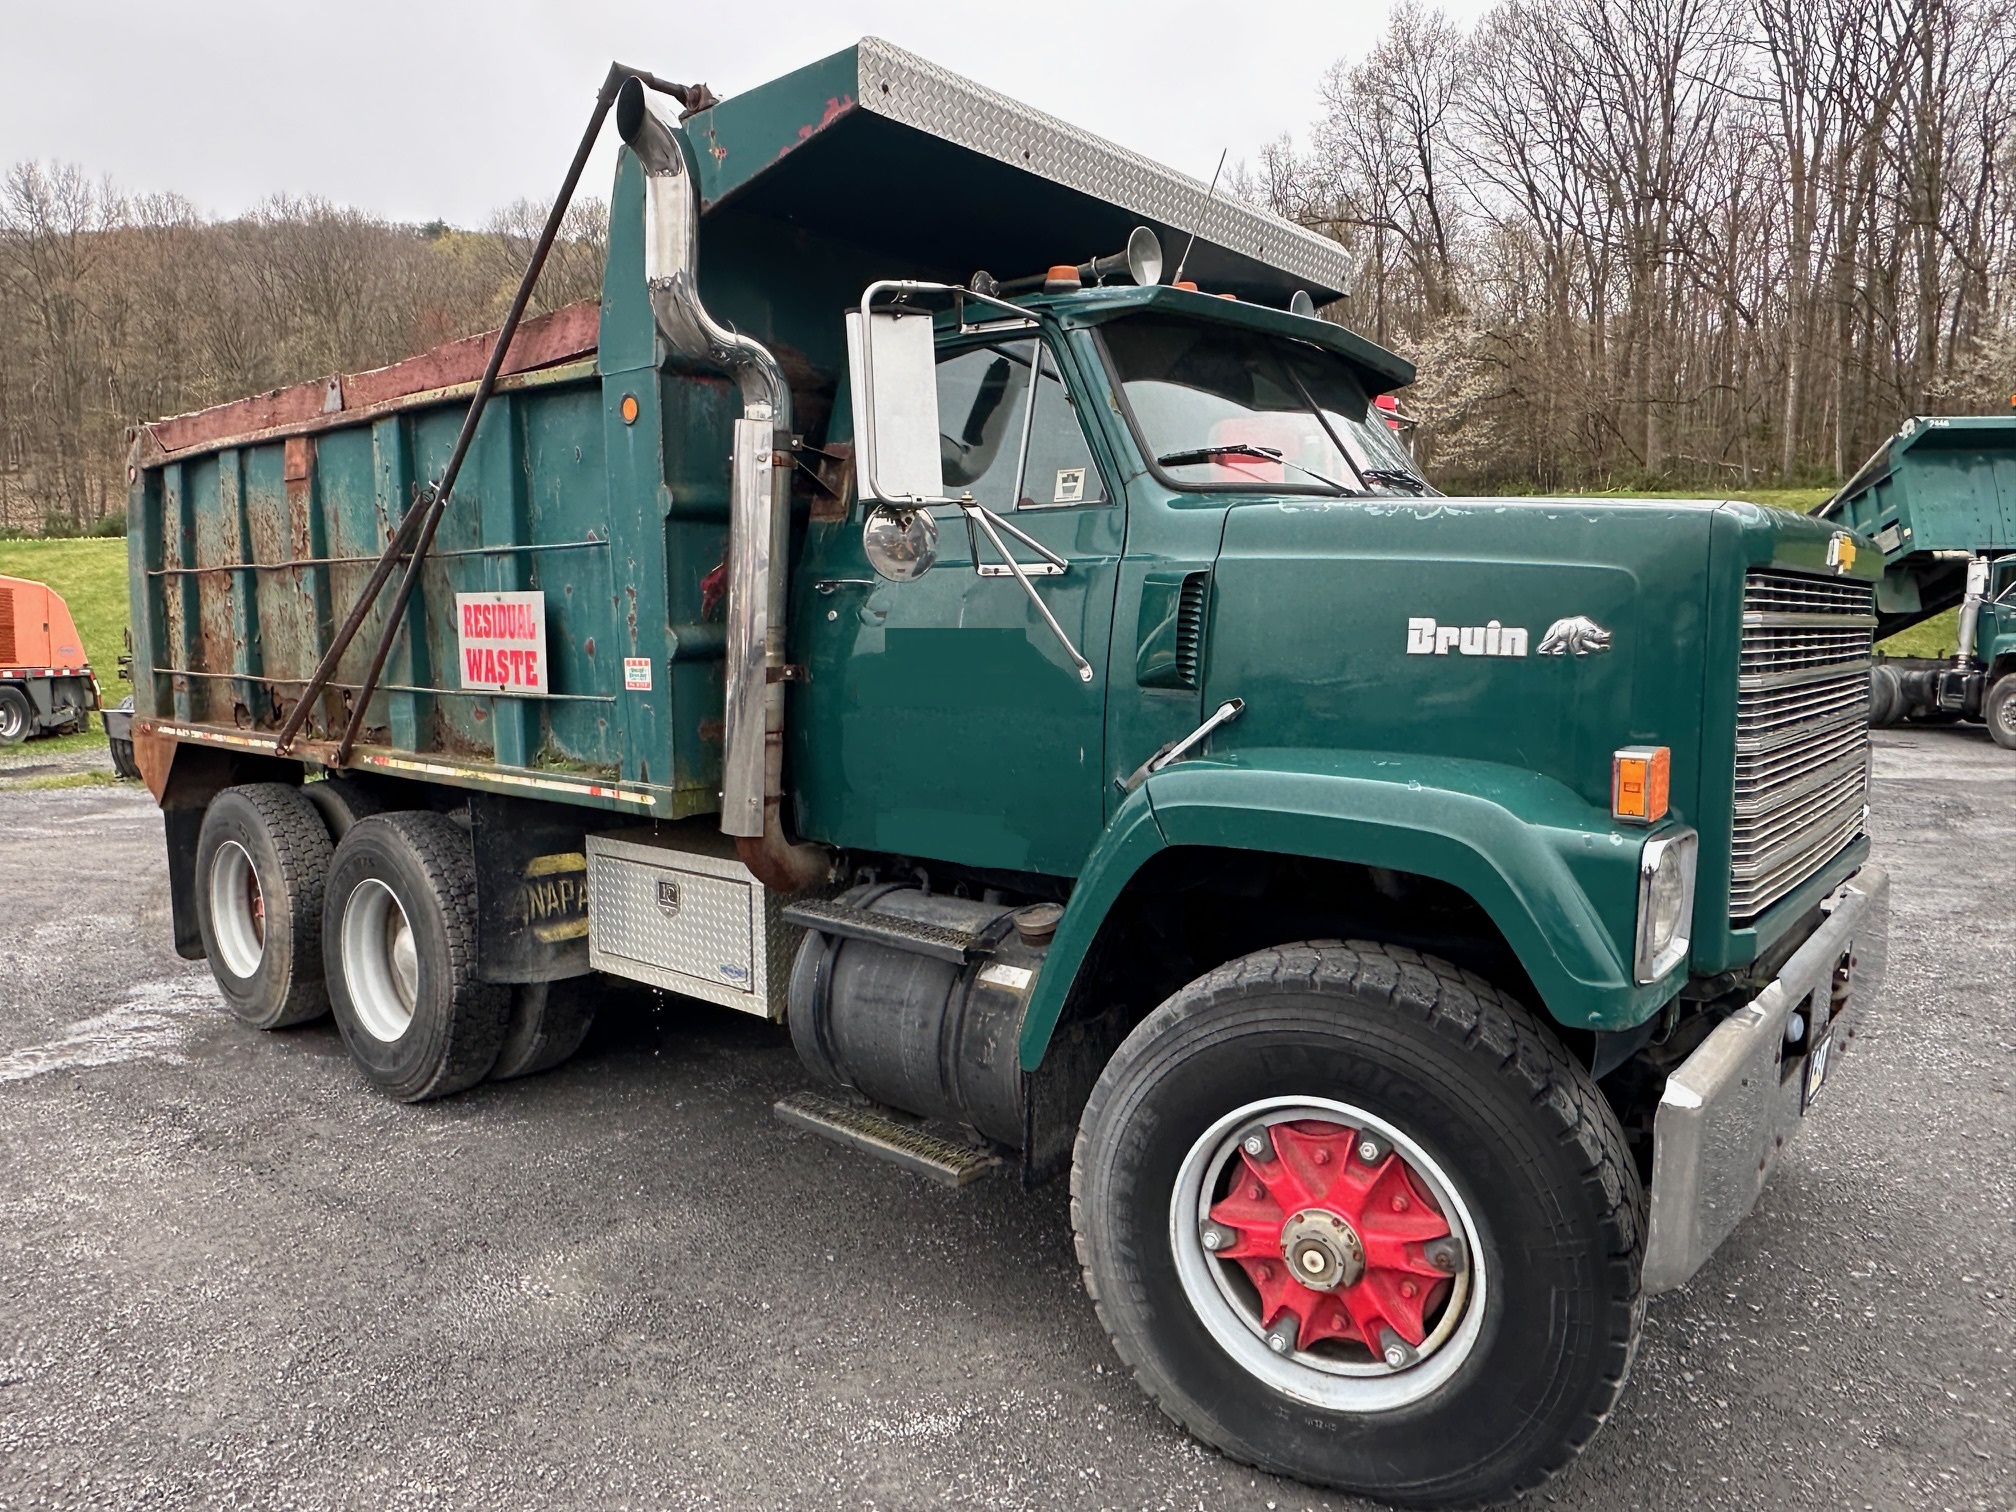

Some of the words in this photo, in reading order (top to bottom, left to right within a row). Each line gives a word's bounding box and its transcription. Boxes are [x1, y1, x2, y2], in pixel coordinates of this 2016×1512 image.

[463, 604, 537, 640] RESIDUAL
[1406, 617, 1528, 657] Bruin
[465, 648, 539, 687] WASTE
[527, 879, 589, 920] NAPA
